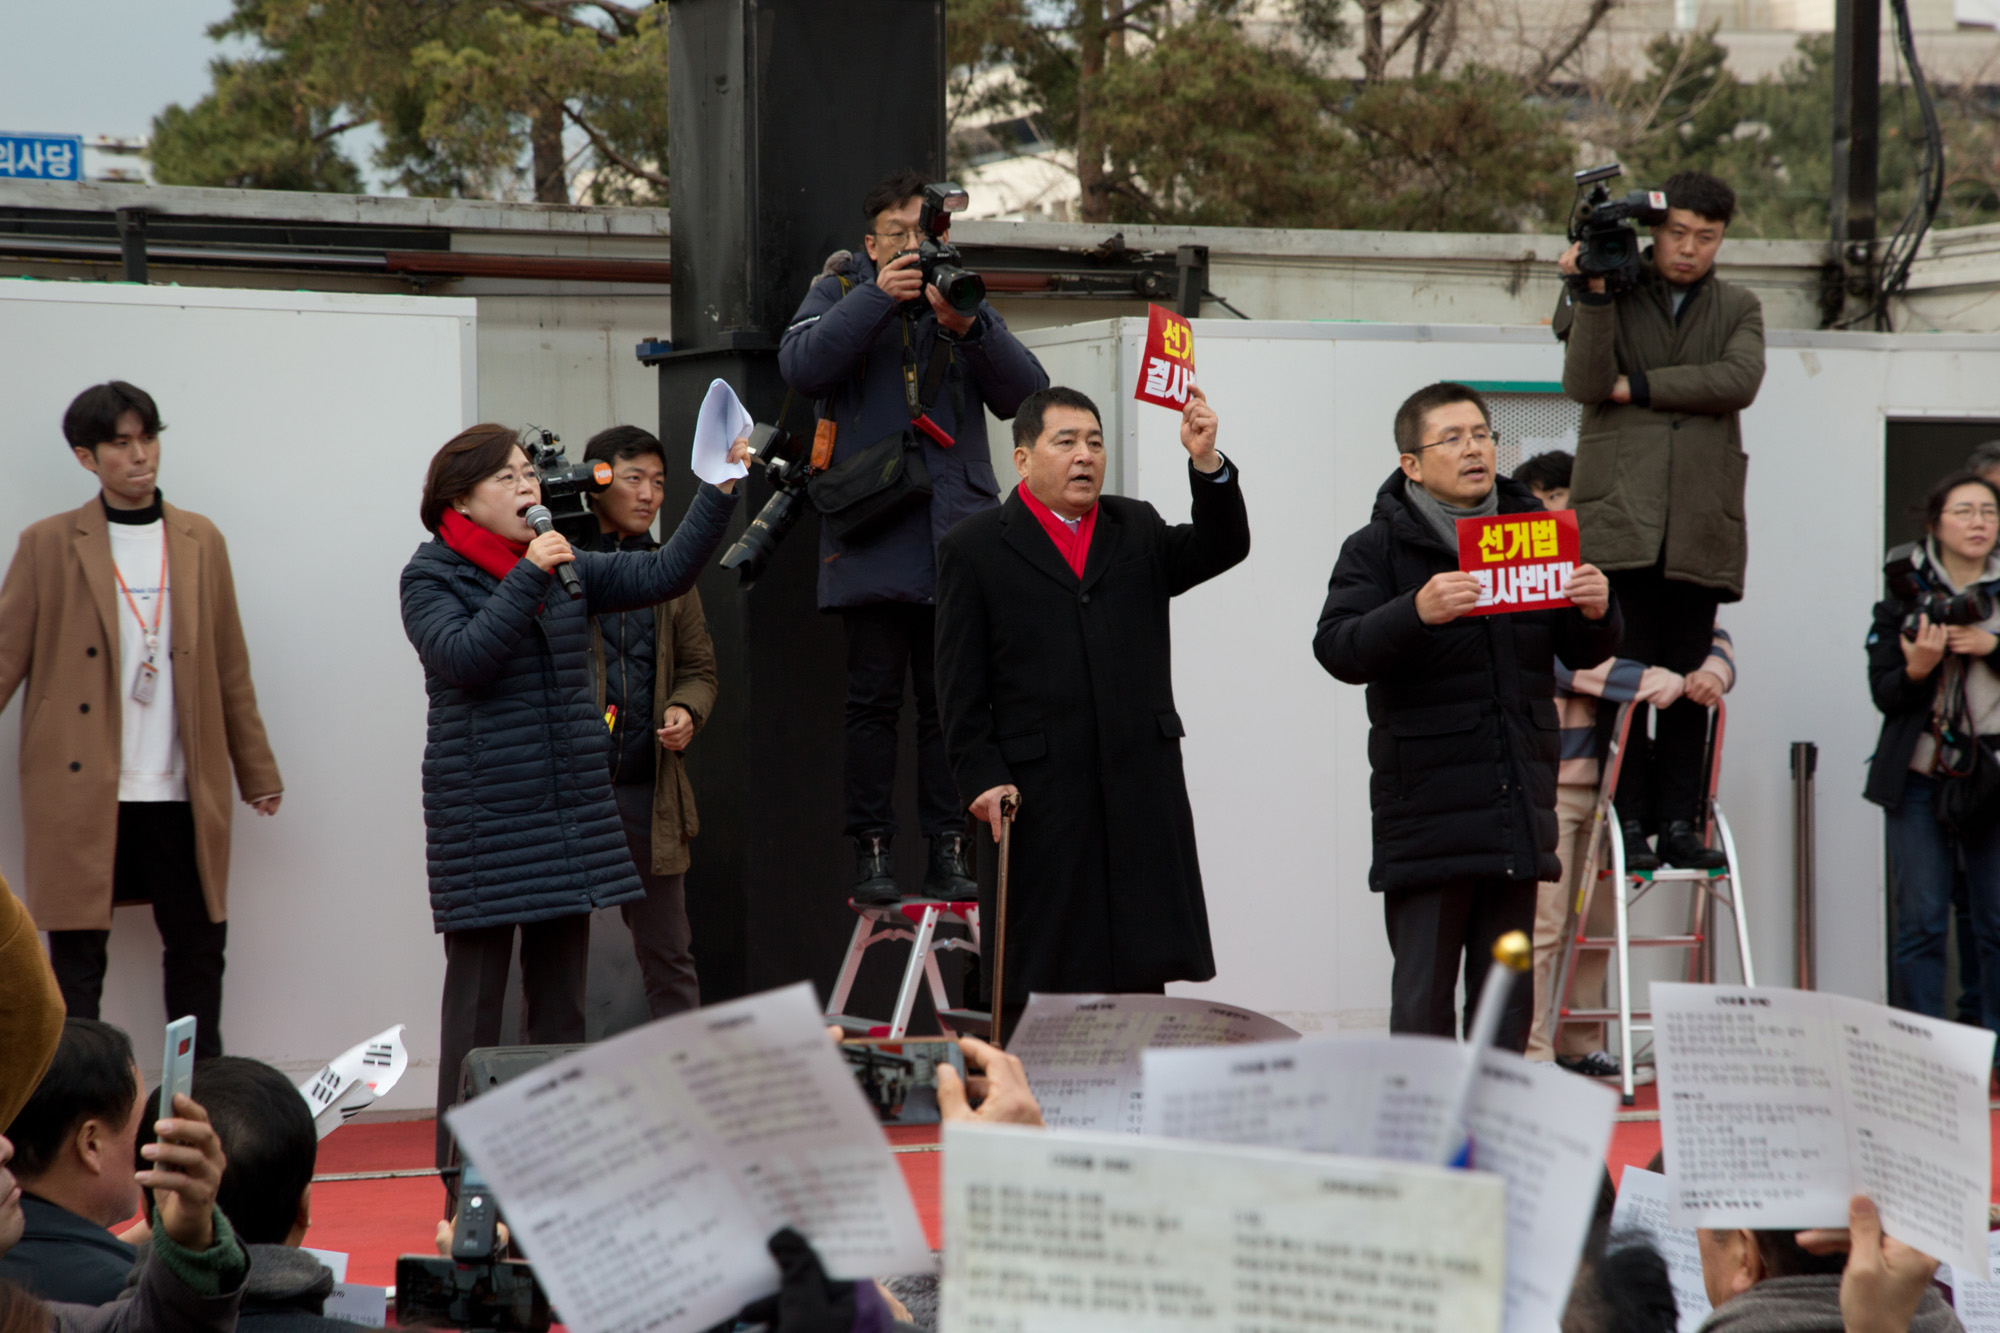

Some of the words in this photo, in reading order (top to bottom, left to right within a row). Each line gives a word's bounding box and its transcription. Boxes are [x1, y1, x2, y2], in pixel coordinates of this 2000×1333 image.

[1144, 356, 1196, 404] 결사
[595, 469, 612, 479] MBN
[1478, 519, 1559, 563] 선거법
